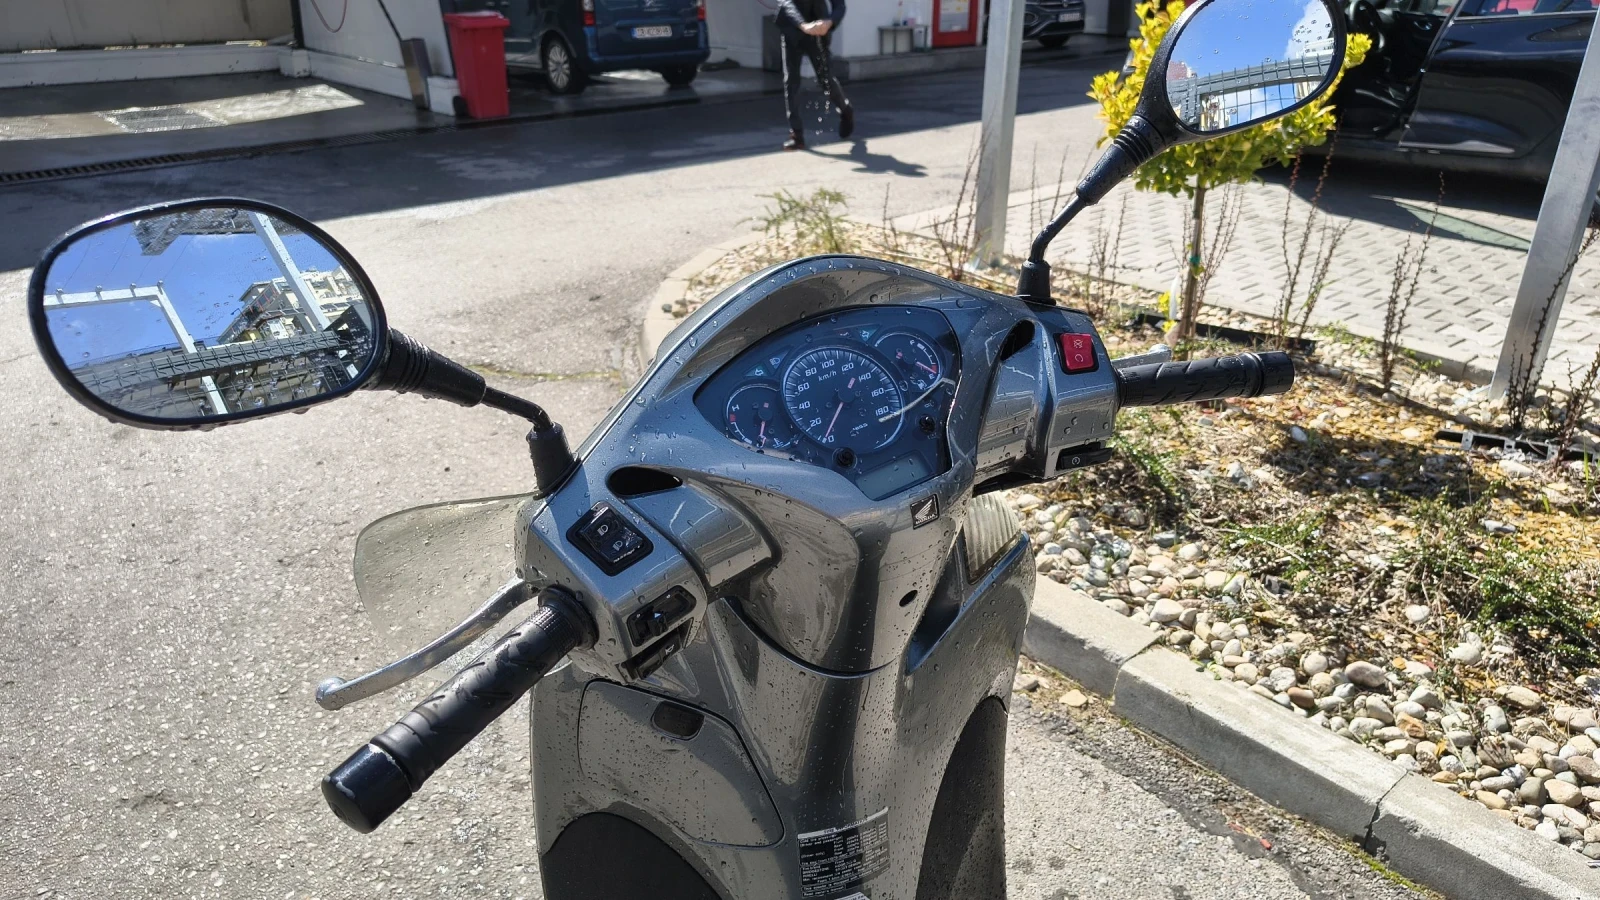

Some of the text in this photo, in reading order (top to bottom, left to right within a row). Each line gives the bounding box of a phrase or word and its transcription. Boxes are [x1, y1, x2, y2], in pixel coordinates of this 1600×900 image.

[821, 359, 835, 370] 100
[841, 362, 855, 372] 120
[805, 367, 818, 377] 80
[818, 370, 837, 382] km/h
[858, 372, 872, 383] 140
[797, 382, 810, 392] 60
[871, 387, 885, 397] 160
[798, 401, 811, 410] 40
[875, 405, 889, 417] 180
[809, 417, 822, 427] 20
[827, 435, 835, 443] 0
